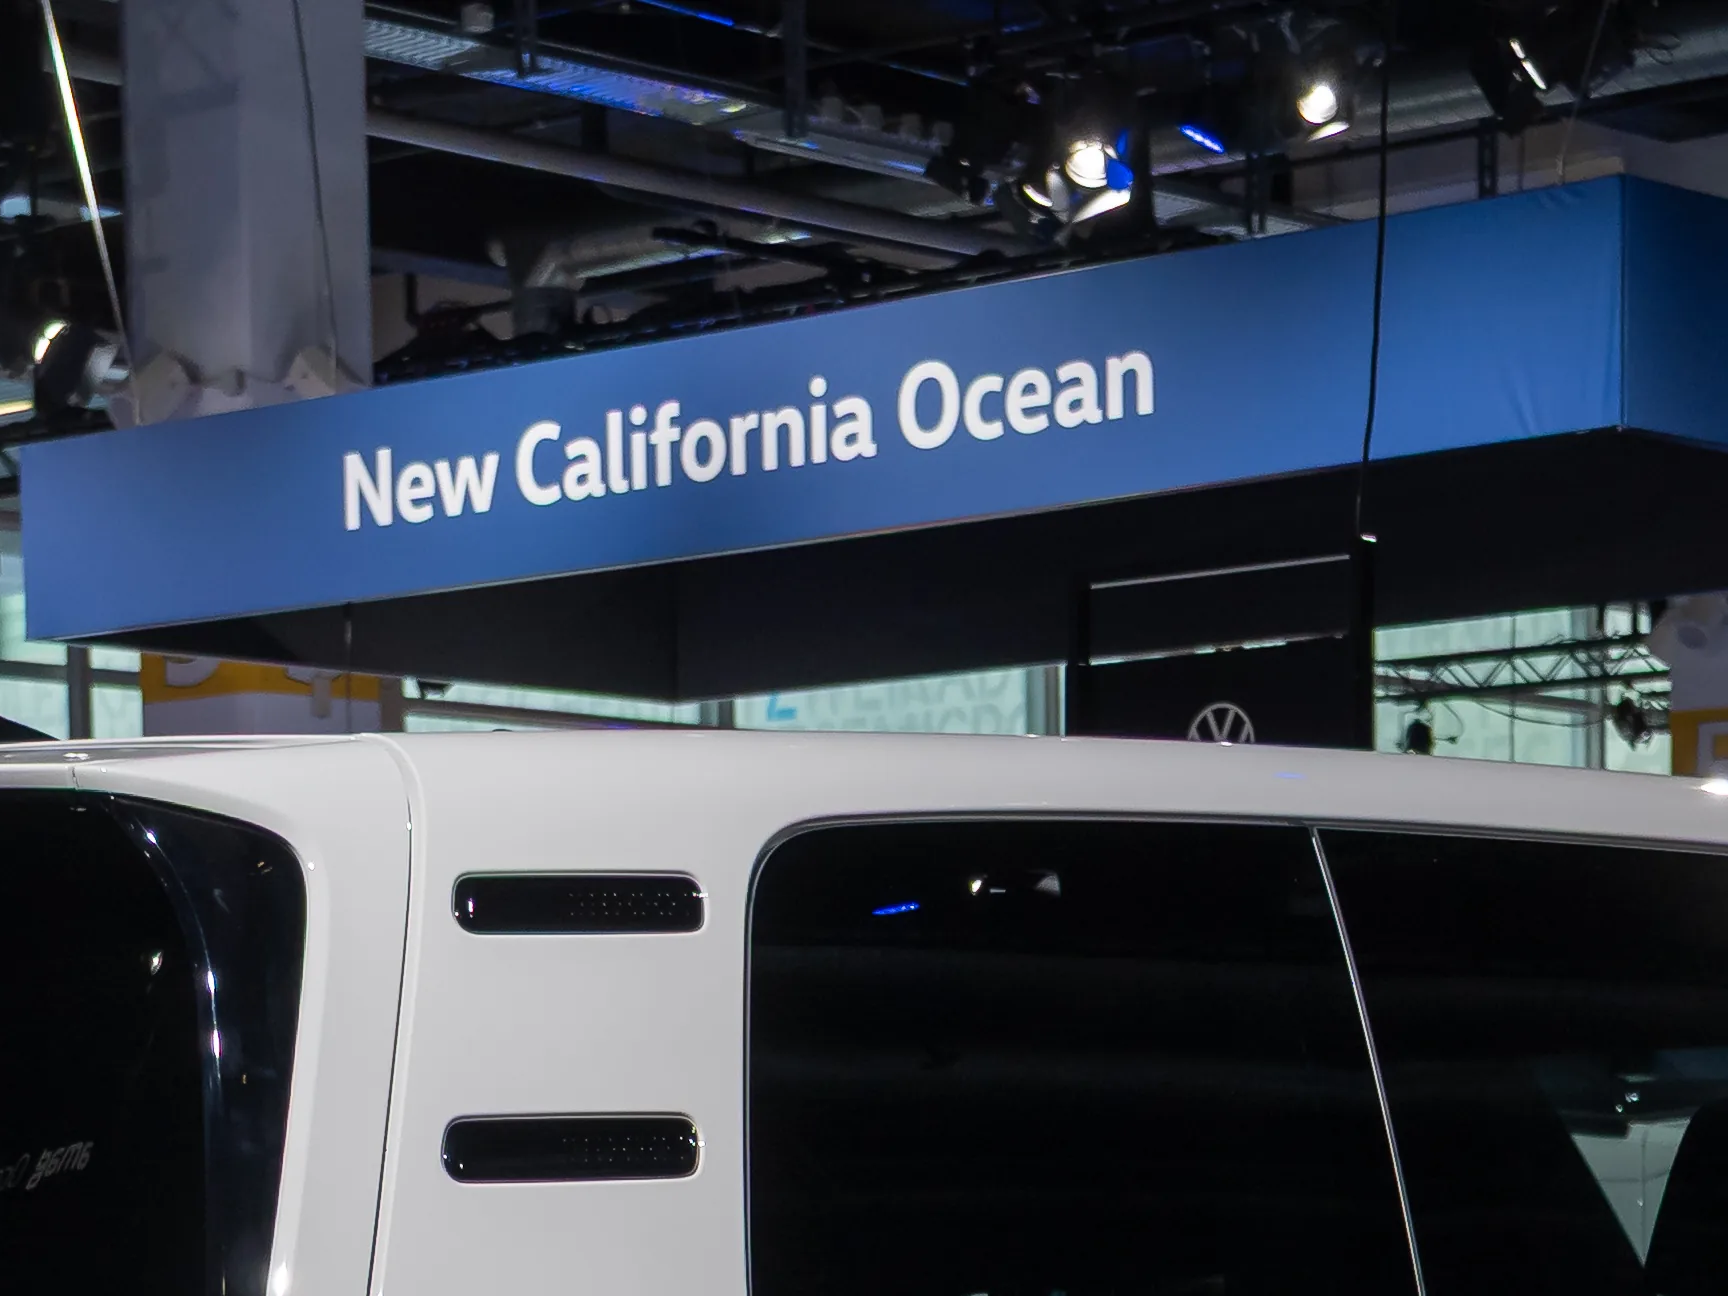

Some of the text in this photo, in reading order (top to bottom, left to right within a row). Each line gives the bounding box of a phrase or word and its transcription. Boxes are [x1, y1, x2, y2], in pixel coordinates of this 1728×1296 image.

[343, 350, 1156, 533] New California Ocean
